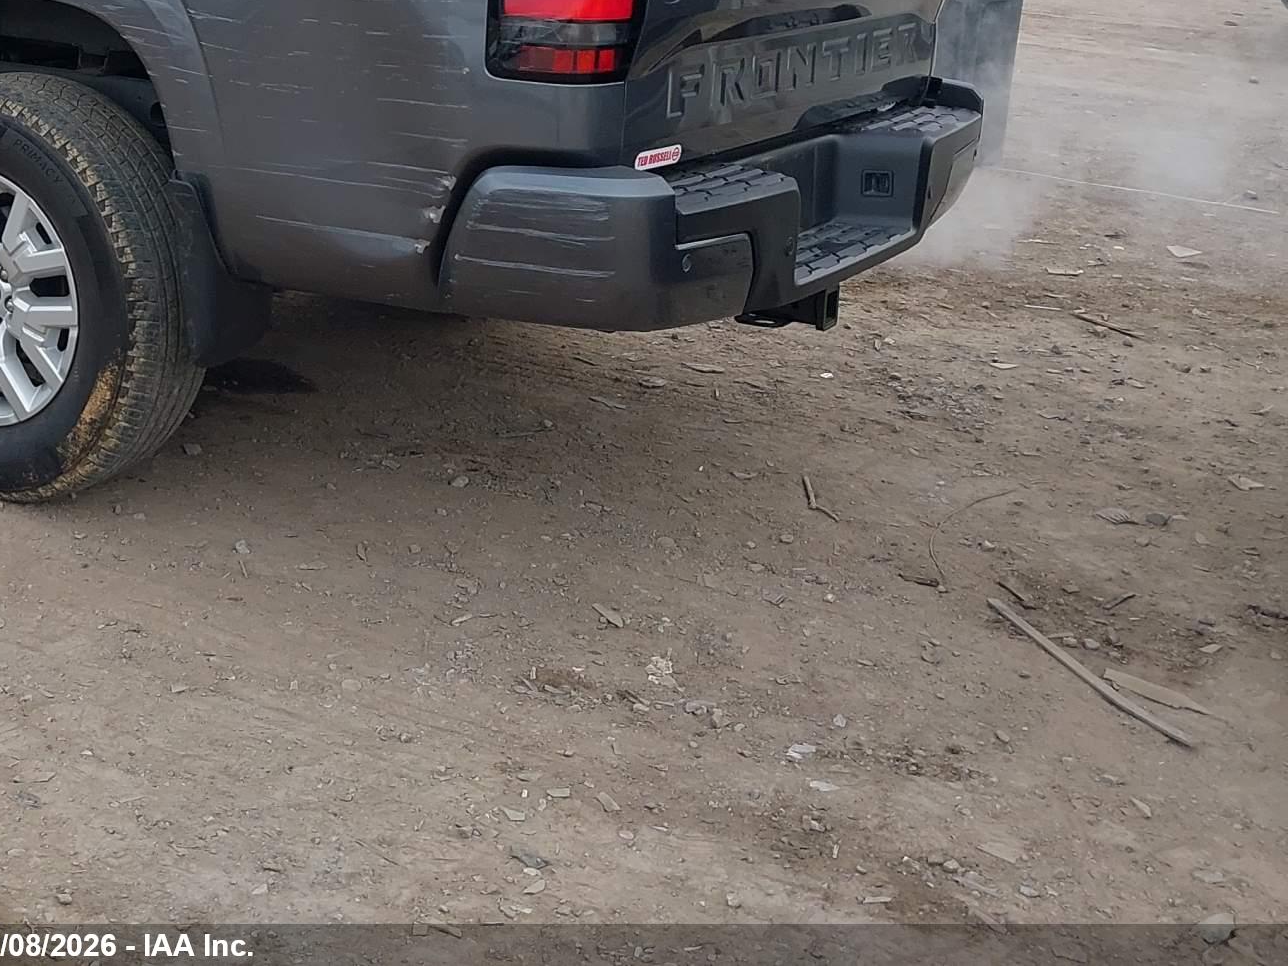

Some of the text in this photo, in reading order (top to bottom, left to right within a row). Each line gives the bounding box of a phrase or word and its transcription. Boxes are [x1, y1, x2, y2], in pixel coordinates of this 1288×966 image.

[666, 22, 920, 118] FRONTIER
[14, 139, 62, 183] PRIMACY
[637, 155, 649, 167] TED
[648, 151, 672, 165] RUSSELL
